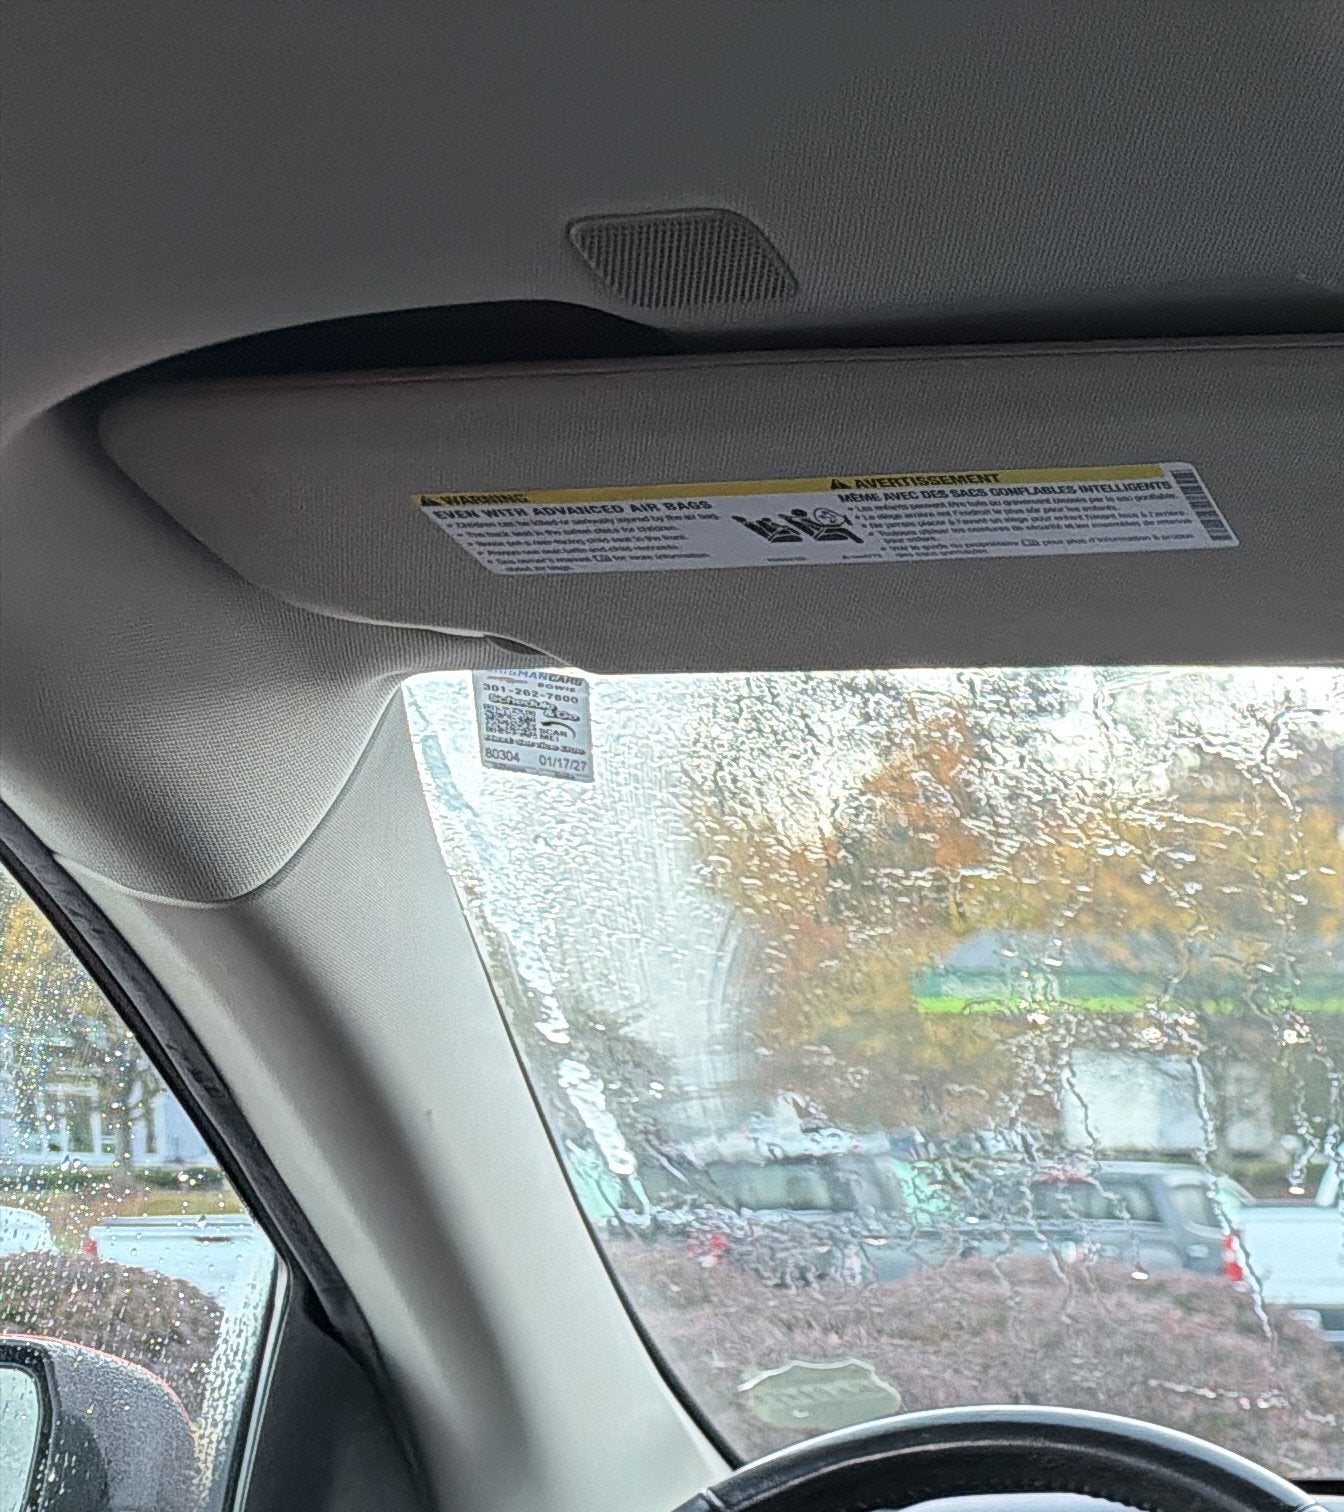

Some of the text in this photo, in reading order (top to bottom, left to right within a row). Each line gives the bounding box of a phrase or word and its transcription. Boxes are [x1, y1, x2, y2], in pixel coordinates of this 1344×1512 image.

[855, 473, 1000, 489] AVERTISSEMENT
[883, 490, 919, 501] AVEC
[920, 489, 949, 500] DES
[949, 488, 988, 498] SACS
[1079, 480, 1172, 493] INTELLIGENTS
[439, 493, 529, 506] WARNING
[433, 500, 713, 520] EVEN WITH ADVANCED AIR BAGS
[537, 682, 576, 693] BOWIE
